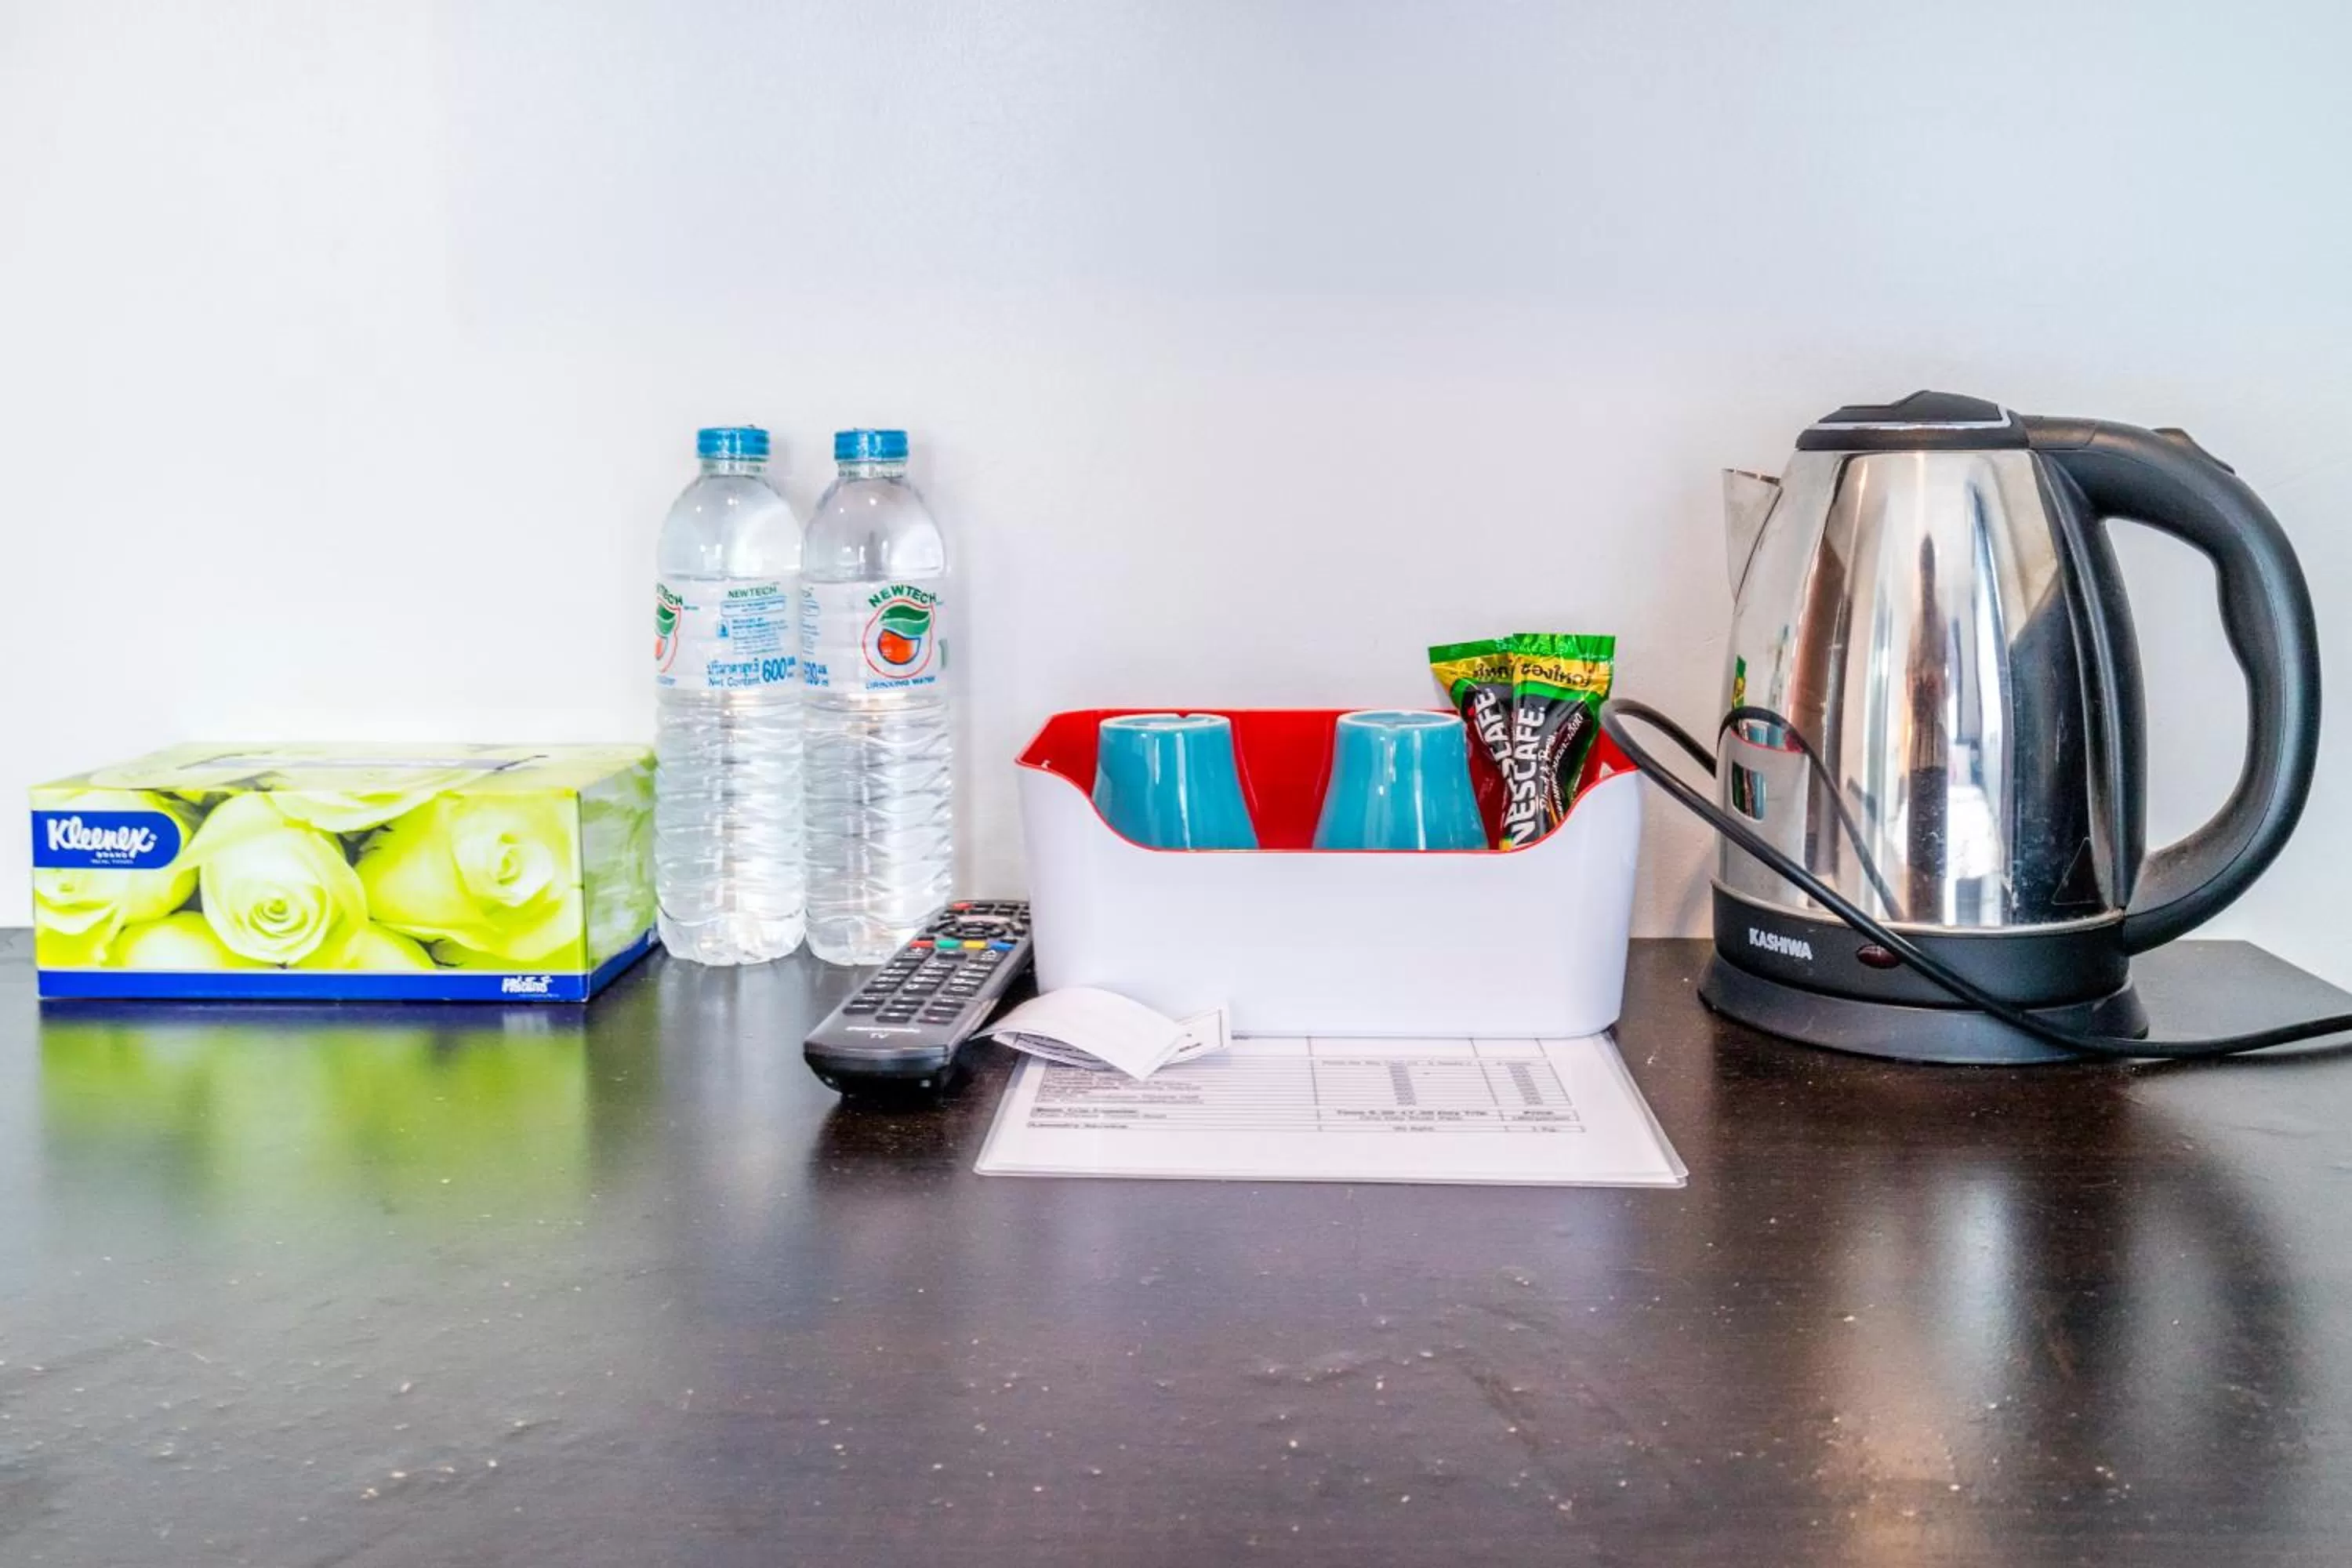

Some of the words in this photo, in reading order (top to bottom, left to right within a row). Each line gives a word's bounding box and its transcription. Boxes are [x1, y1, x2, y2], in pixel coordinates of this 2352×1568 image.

[728, 586, 777, 597] NEWTECH
[868, 584, 936, 608] NEWTECH
[763, 657, 786, 683] 600
[47, 815, 154, 858] Kleenex
[1749, 927, 1813, 960] KASHIWA
